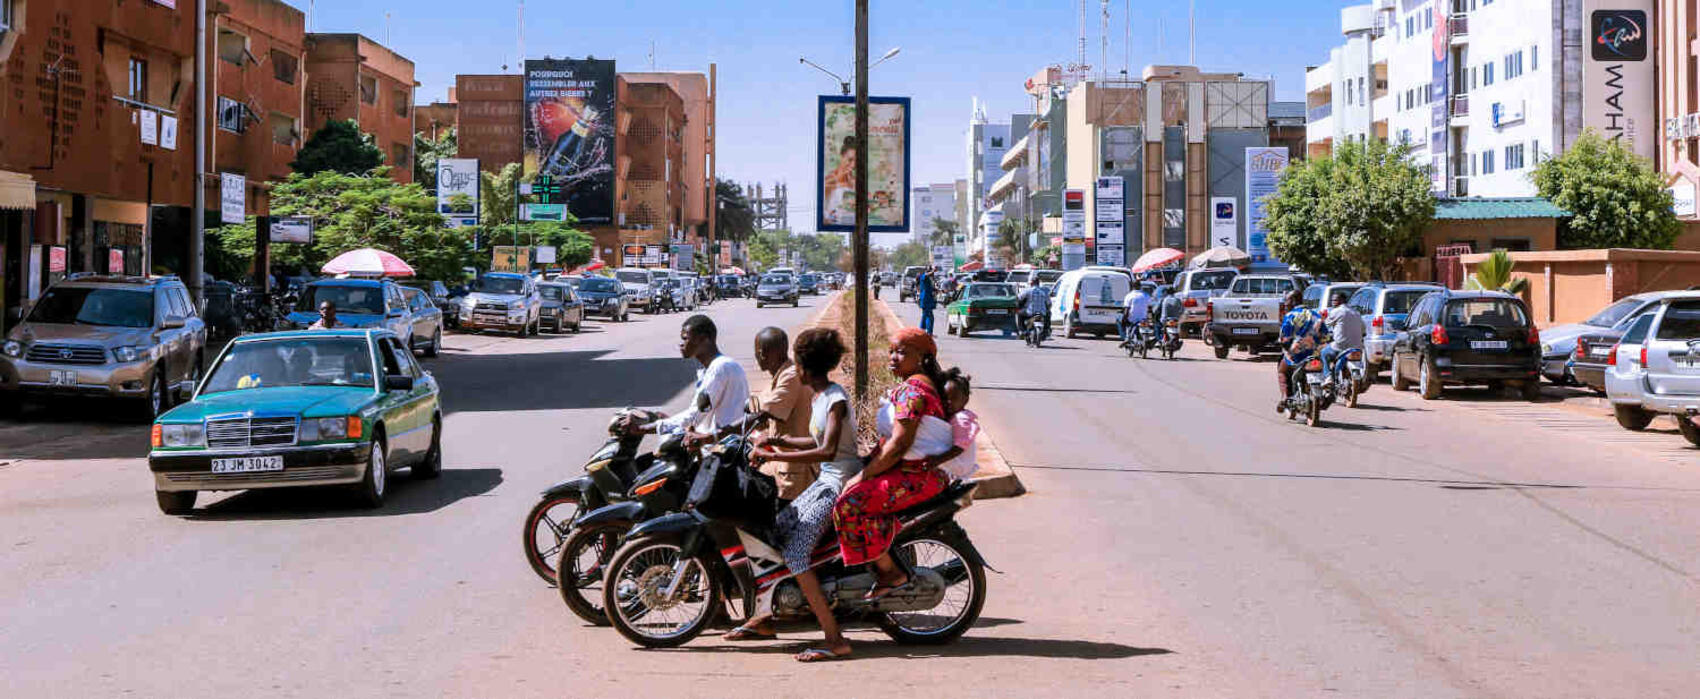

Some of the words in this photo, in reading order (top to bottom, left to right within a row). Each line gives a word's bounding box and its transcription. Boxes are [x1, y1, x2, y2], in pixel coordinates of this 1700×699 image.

[1224, 311, 1268, 320] TOYOTA
[213, 460, 226, 471] 23
[230, 459, 245, 470] JM
[248, 458, 276, 470] 3042
